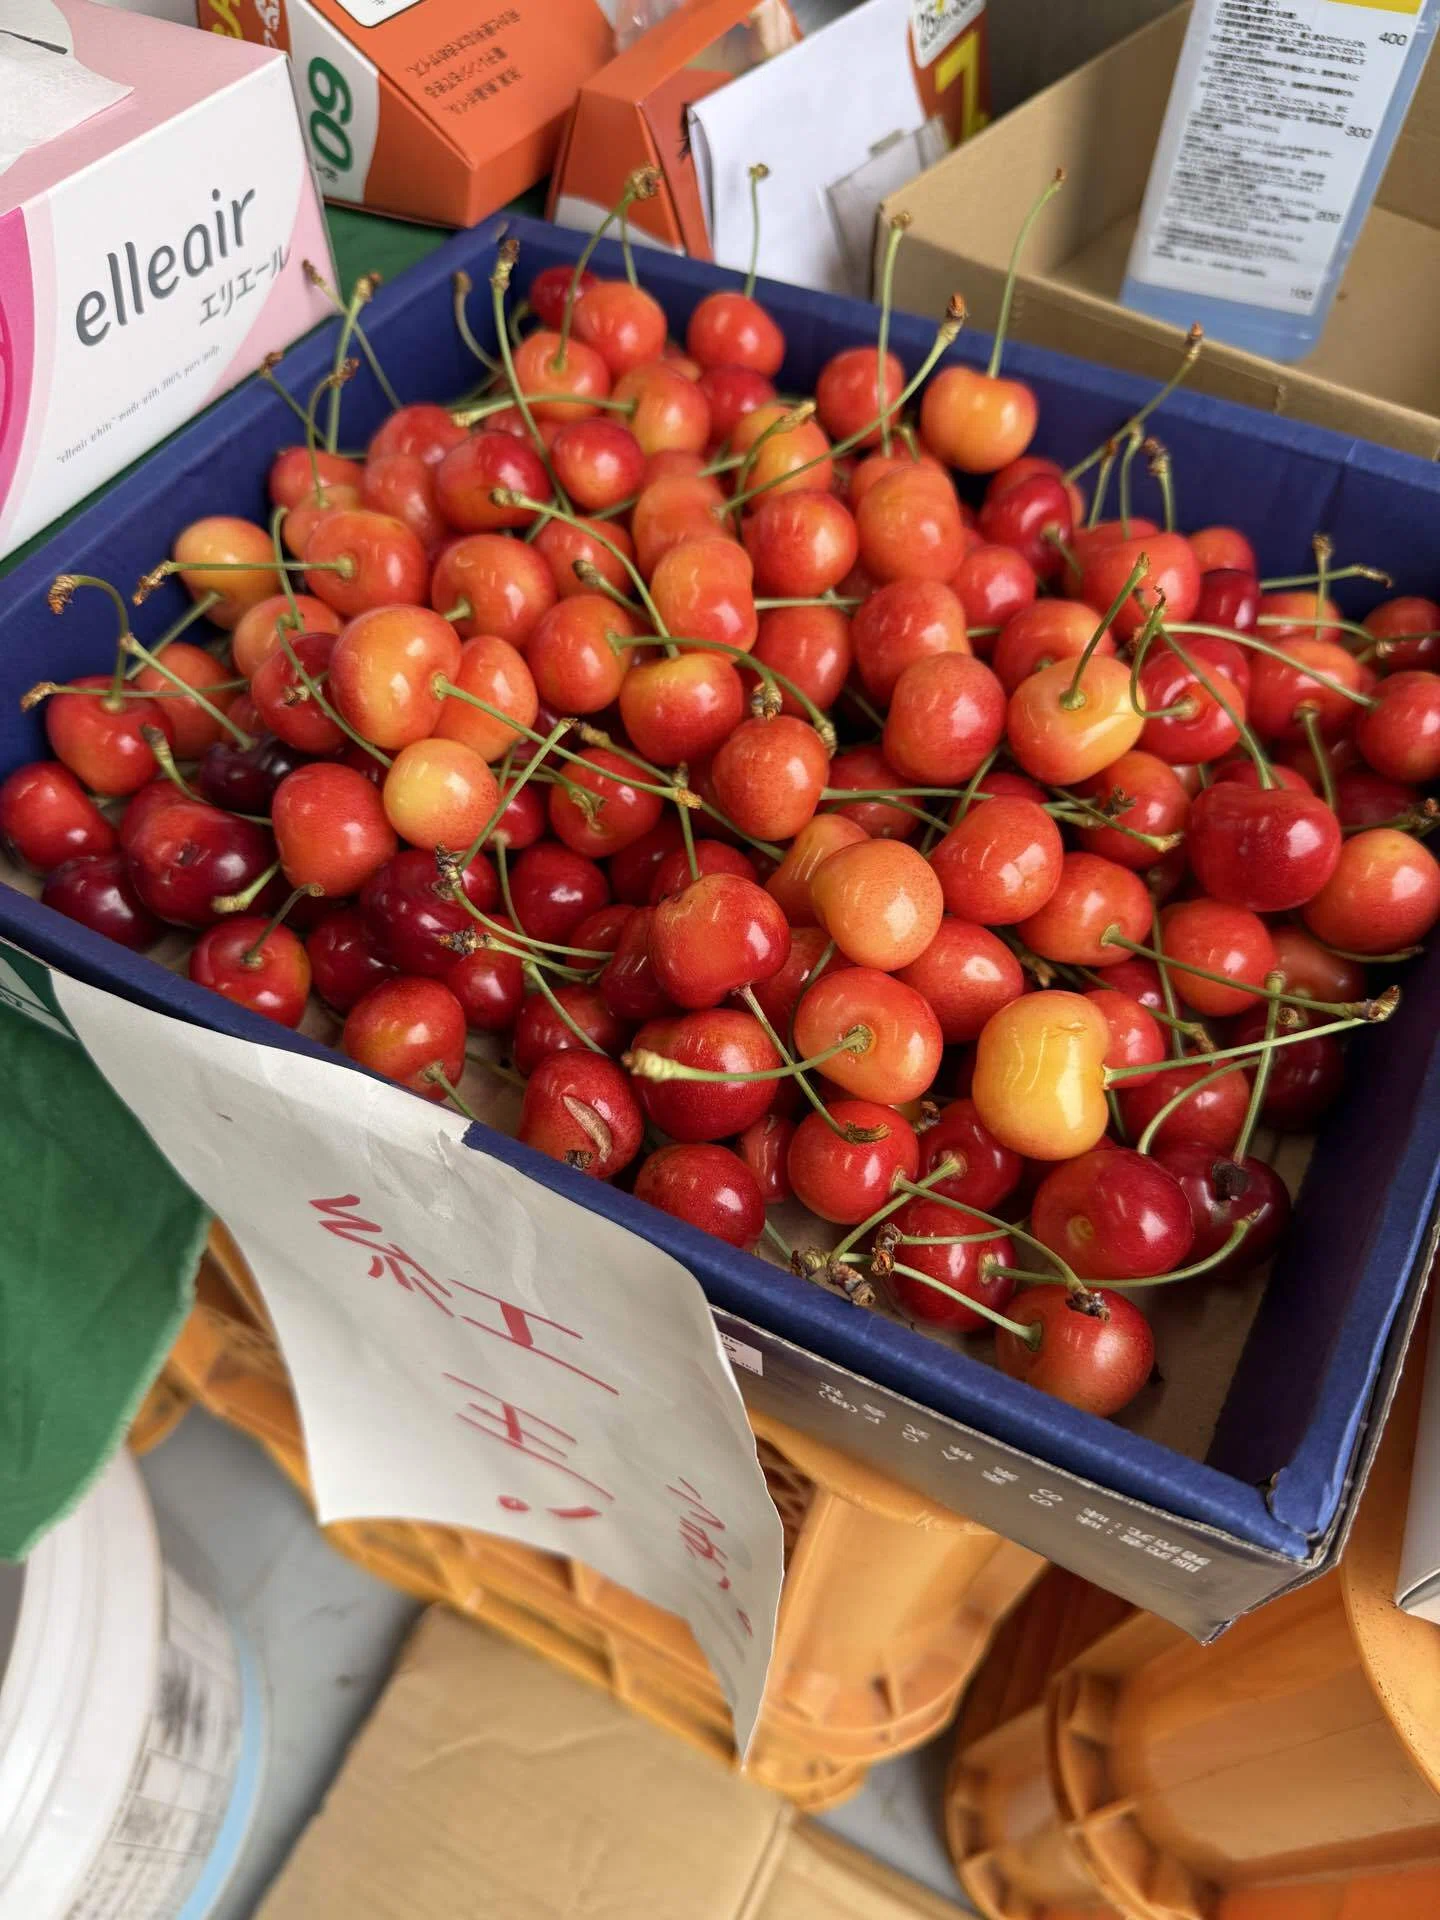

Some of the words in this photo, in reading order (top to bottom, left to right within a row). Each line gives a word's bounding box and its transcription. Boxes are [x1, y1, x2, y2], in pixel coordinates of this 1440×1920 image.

[1379, 32, 1408, 46] 400
[308, 57, 353, 172] 60
[1345, 126, 1373, 139] 300
[76, 188, 255, 347] elleair
[199, 245, 292, 327] エリエール
